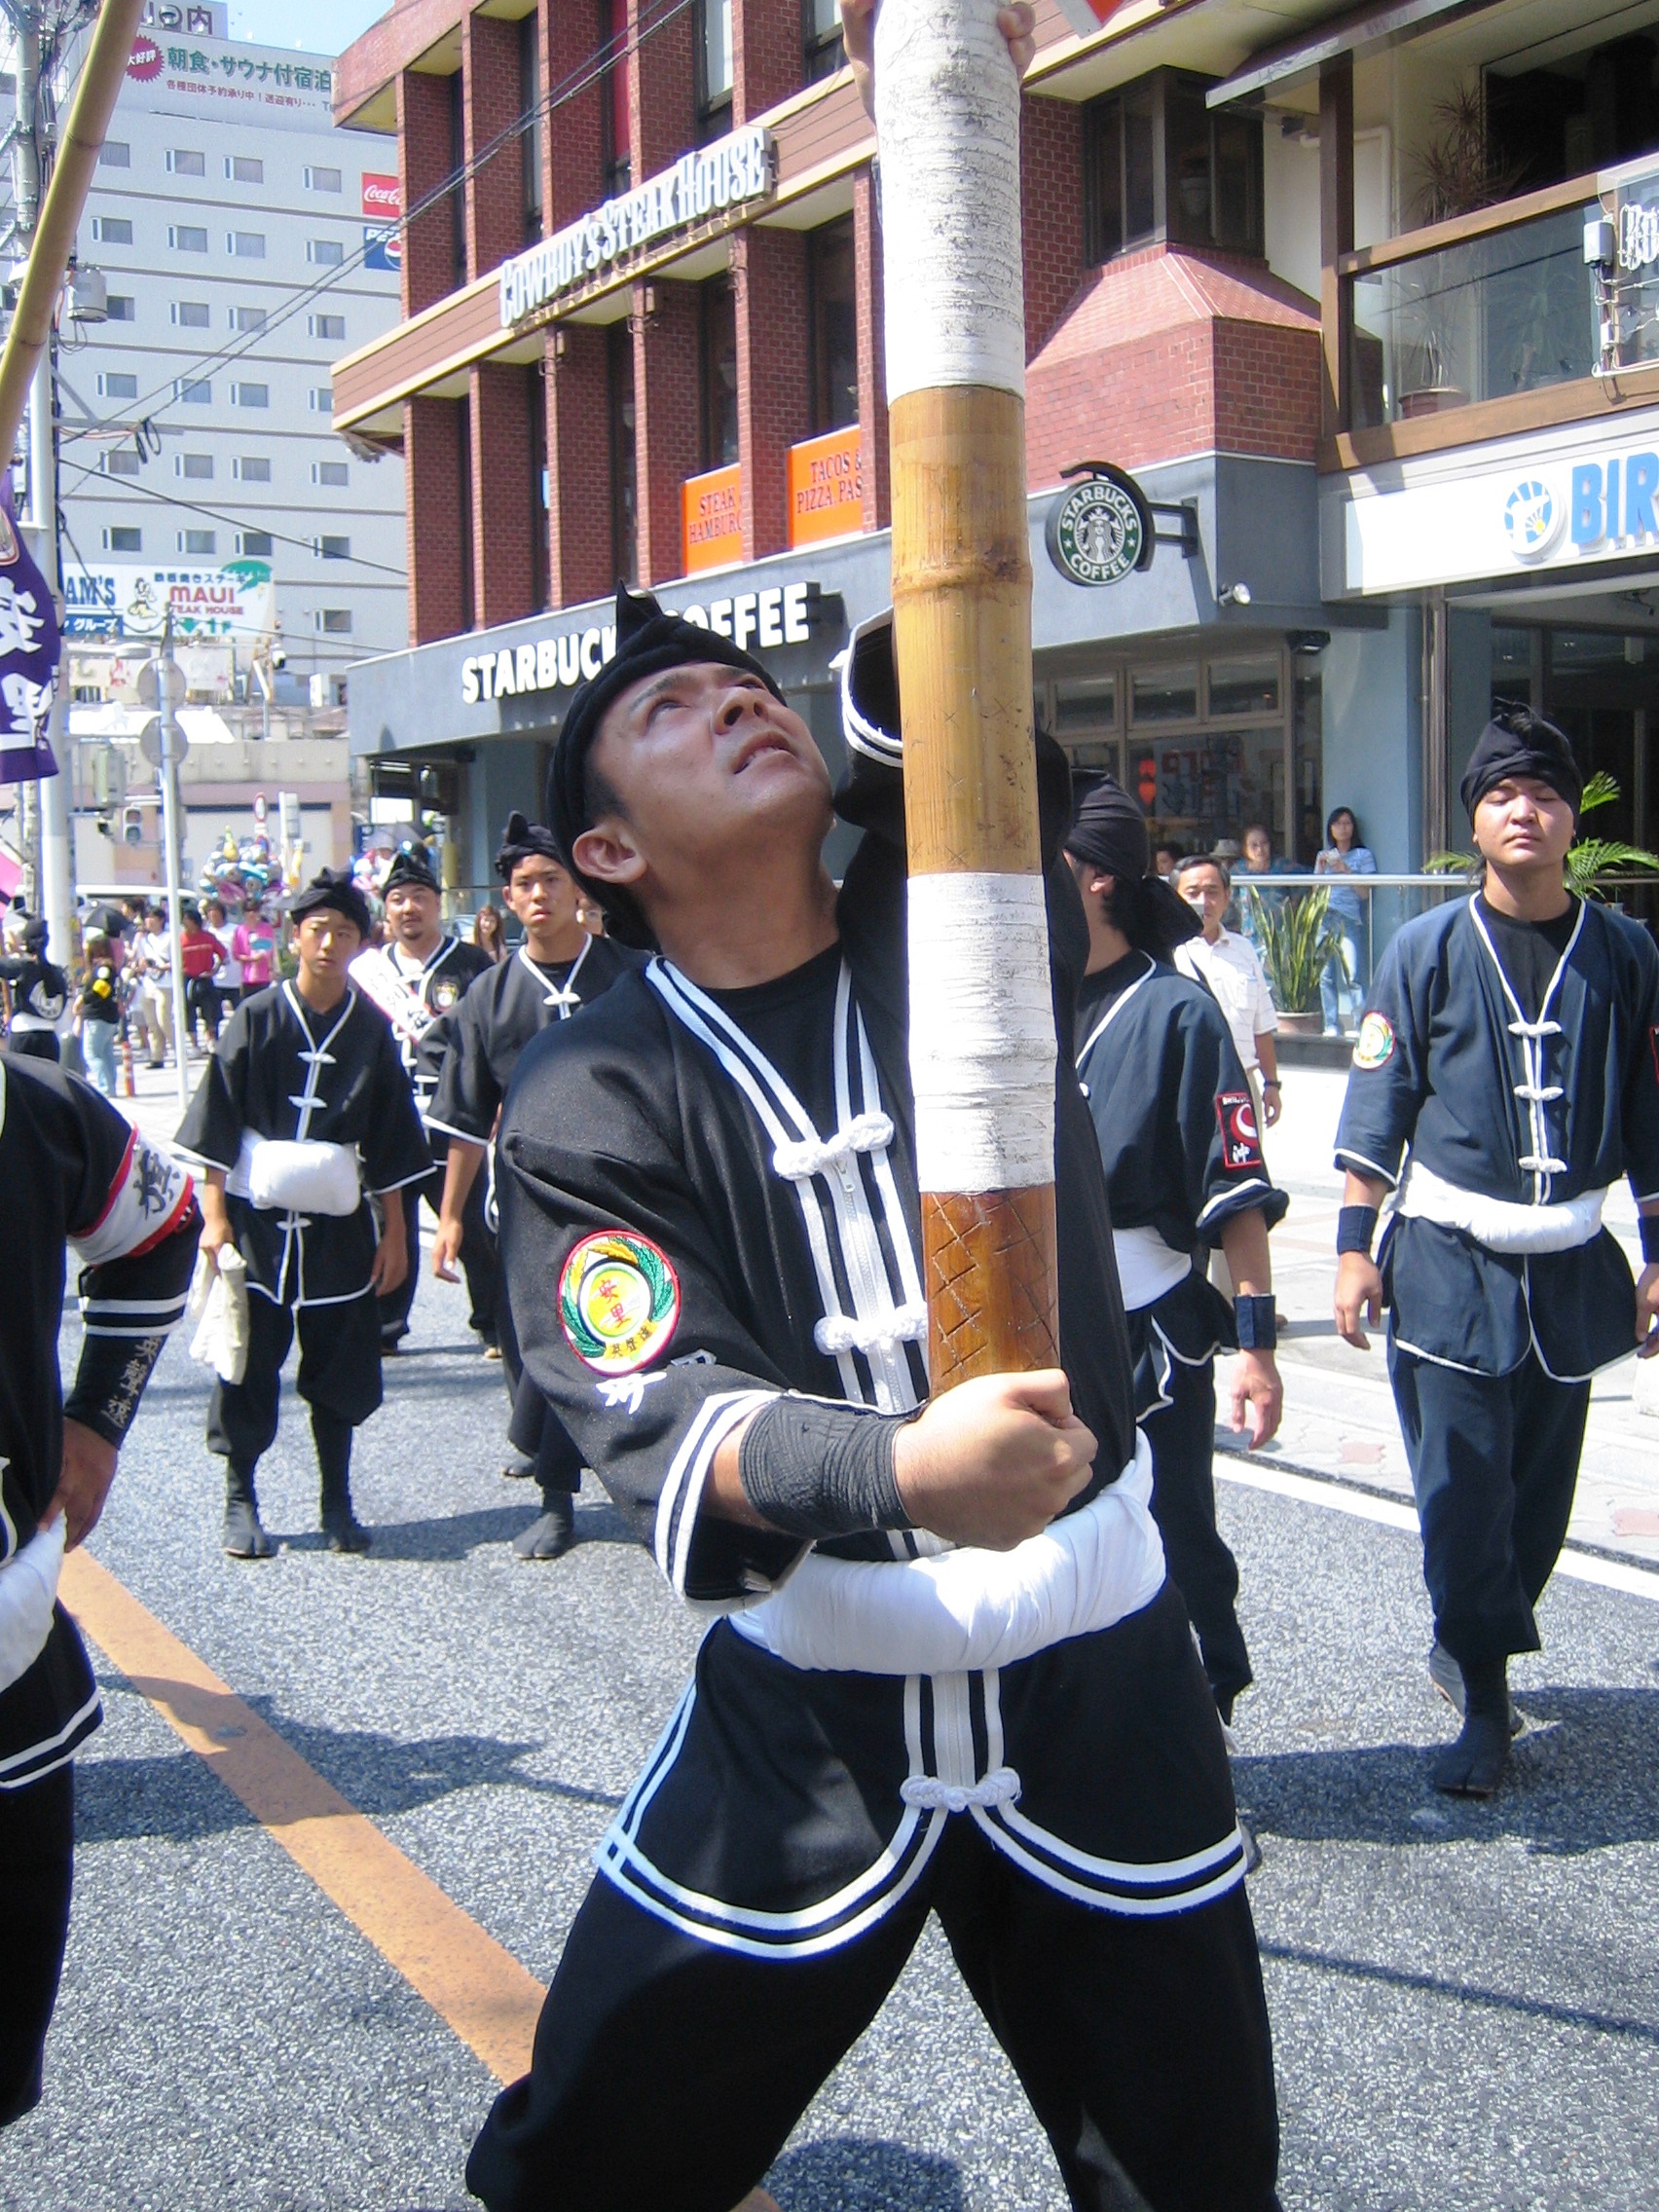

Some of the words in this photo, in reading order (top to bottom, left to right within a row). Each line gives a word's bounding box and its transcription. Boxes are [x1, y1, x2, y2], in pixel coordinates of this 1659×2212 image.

[600, 175, 682, 263] STEAK
[677, 126, 769, 225] HOUSE
[810, 452, 850, 484] TACOS
[700, 487, 735, 517] STEAK
[1061, 486, 1137, 532] STARBUCKS
[1070, 553, 1130, 580] COFFEE
[65, 574, 116, 606] AM'S
[169, 585, 235, 604] MAUI
[172, 605, 202, 615] TEAK
[205, 606, 243, 615] HOUSE
